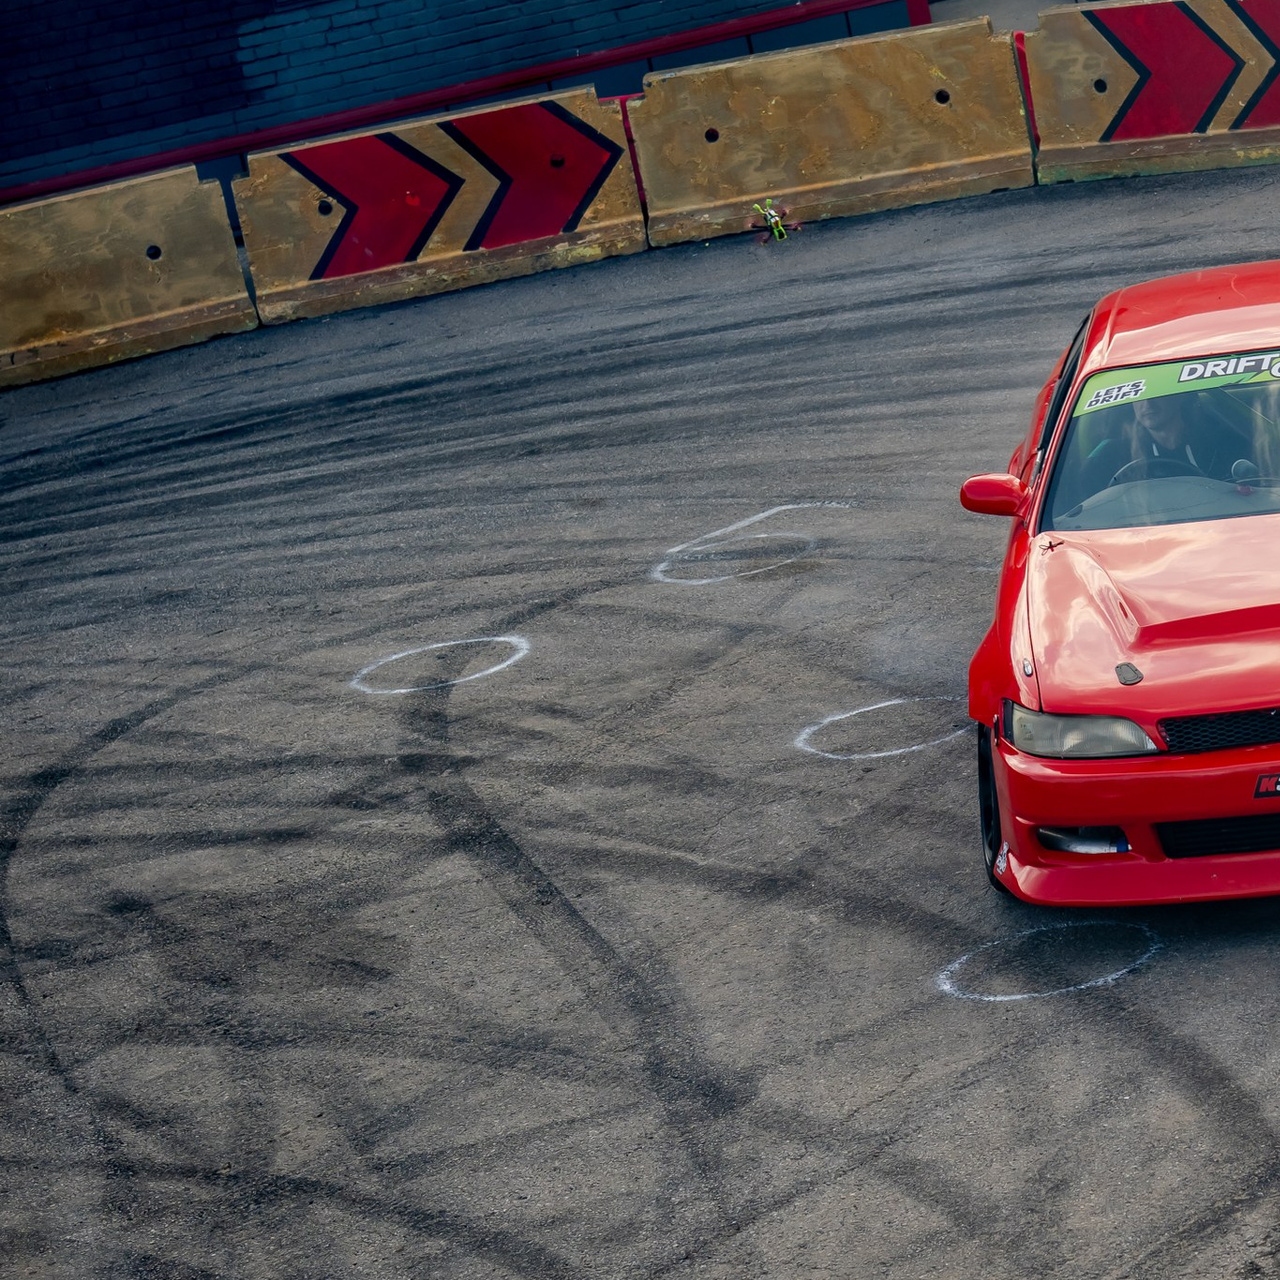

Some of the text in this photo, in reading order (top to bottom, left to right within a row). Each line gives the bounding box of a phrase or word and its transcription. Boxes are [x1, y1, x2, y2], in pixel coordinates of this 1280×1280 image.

[1179, 353, 1280, 382] DRIFT
[1086, 388, 1143, 408] DRIFT
[1094, 381, 1143, 399] LET'S
